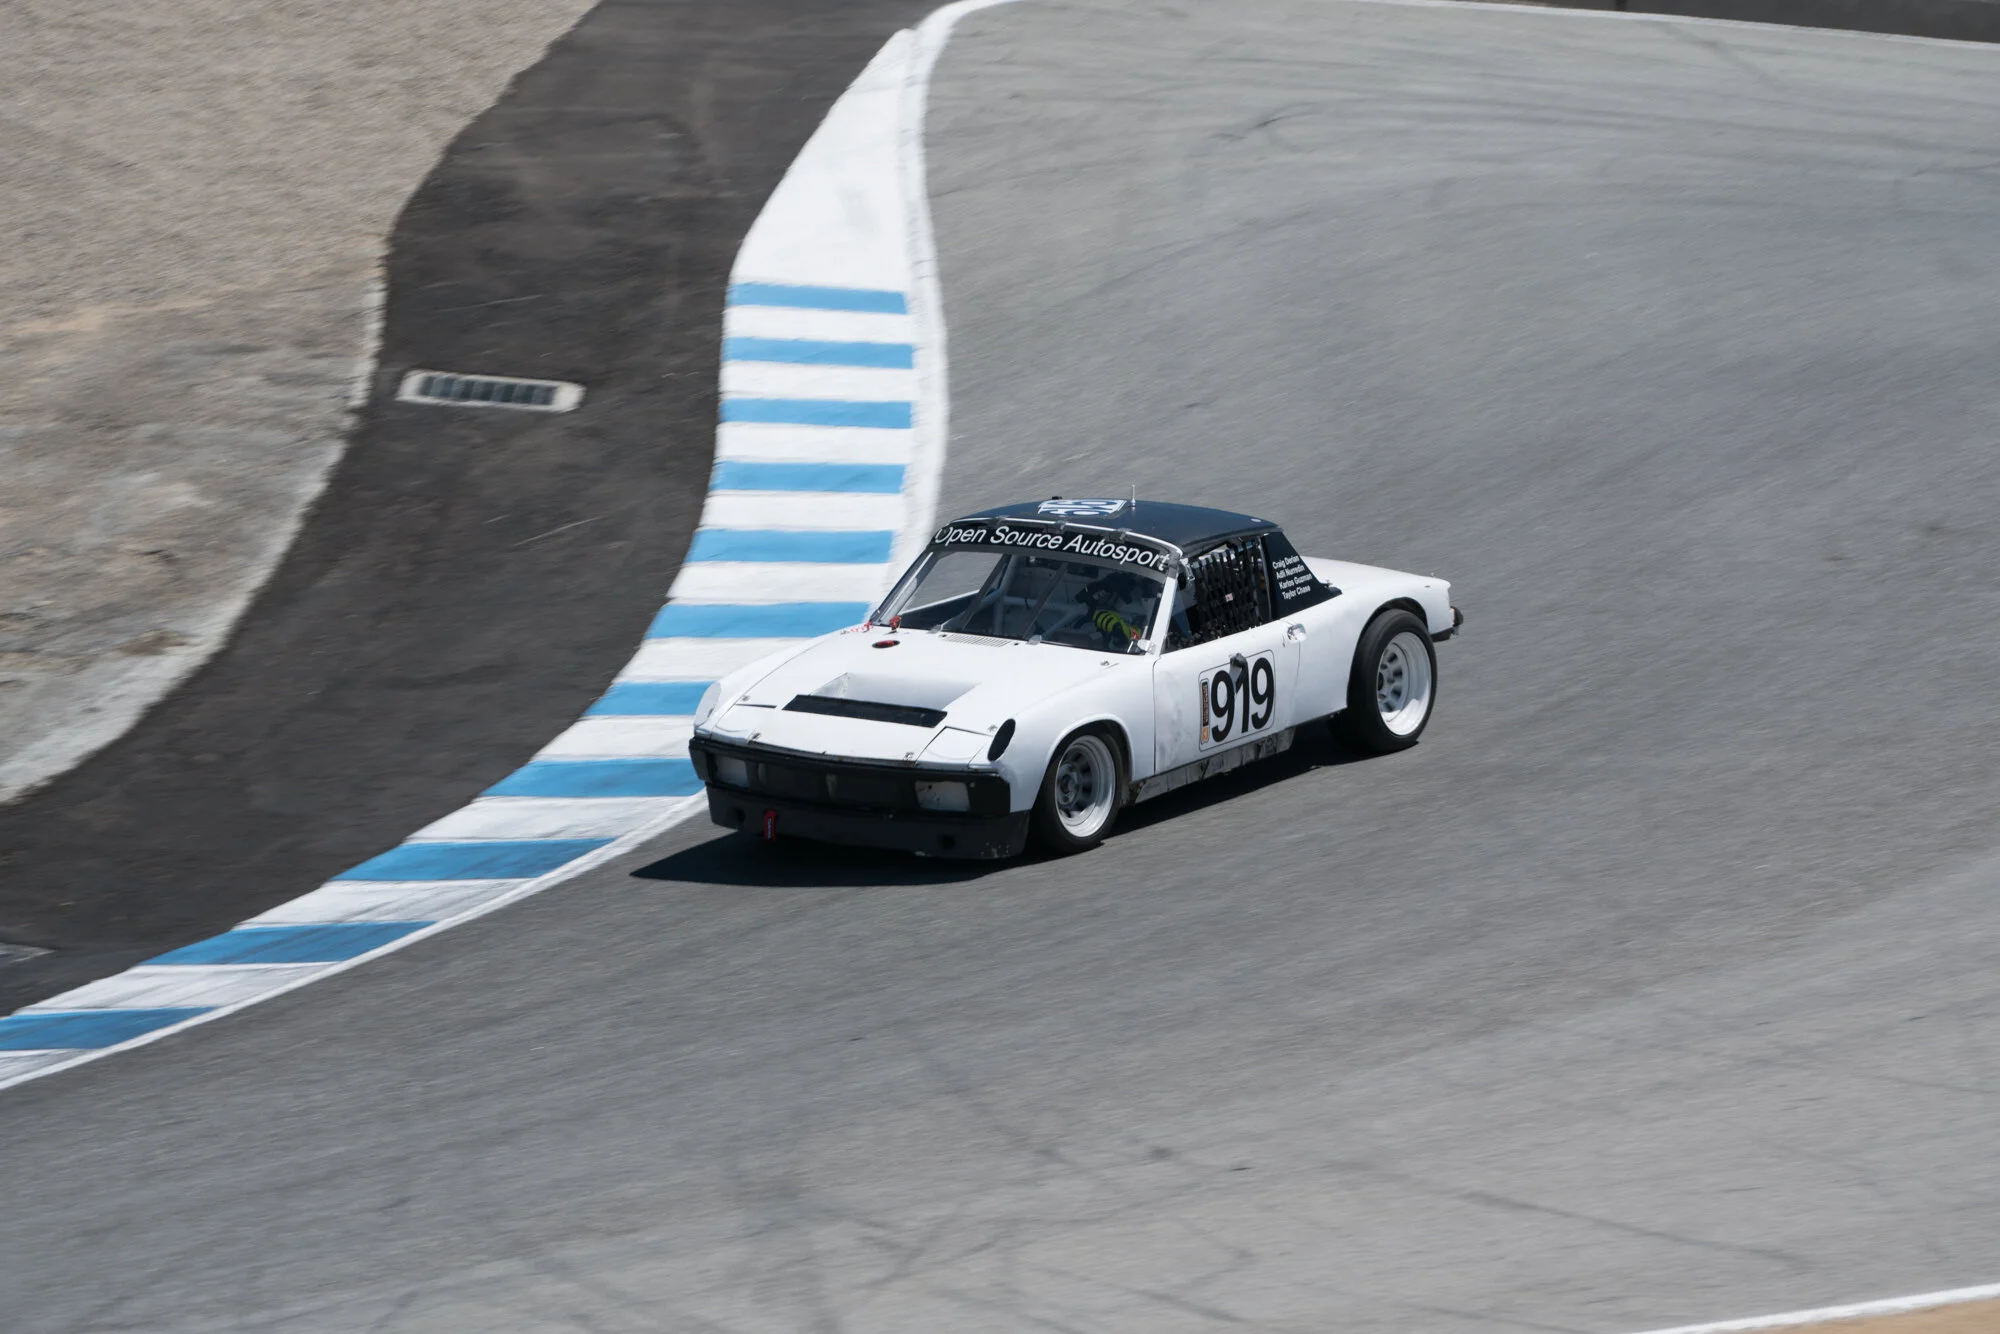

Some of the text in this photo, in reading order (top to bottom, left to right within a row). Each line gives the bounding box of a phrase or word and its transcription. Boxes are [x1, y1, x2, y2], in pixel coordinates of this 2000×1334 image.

[934, 525, 1170, 572] Open Source Autosport
[1272, 560, 1286, 569] Craig
[1279, 573, 1313, 590] Karlos Guzman
[1282, 585, 1311, 600] Taylor Chase
[1211, 657, 1274, 743] 919
